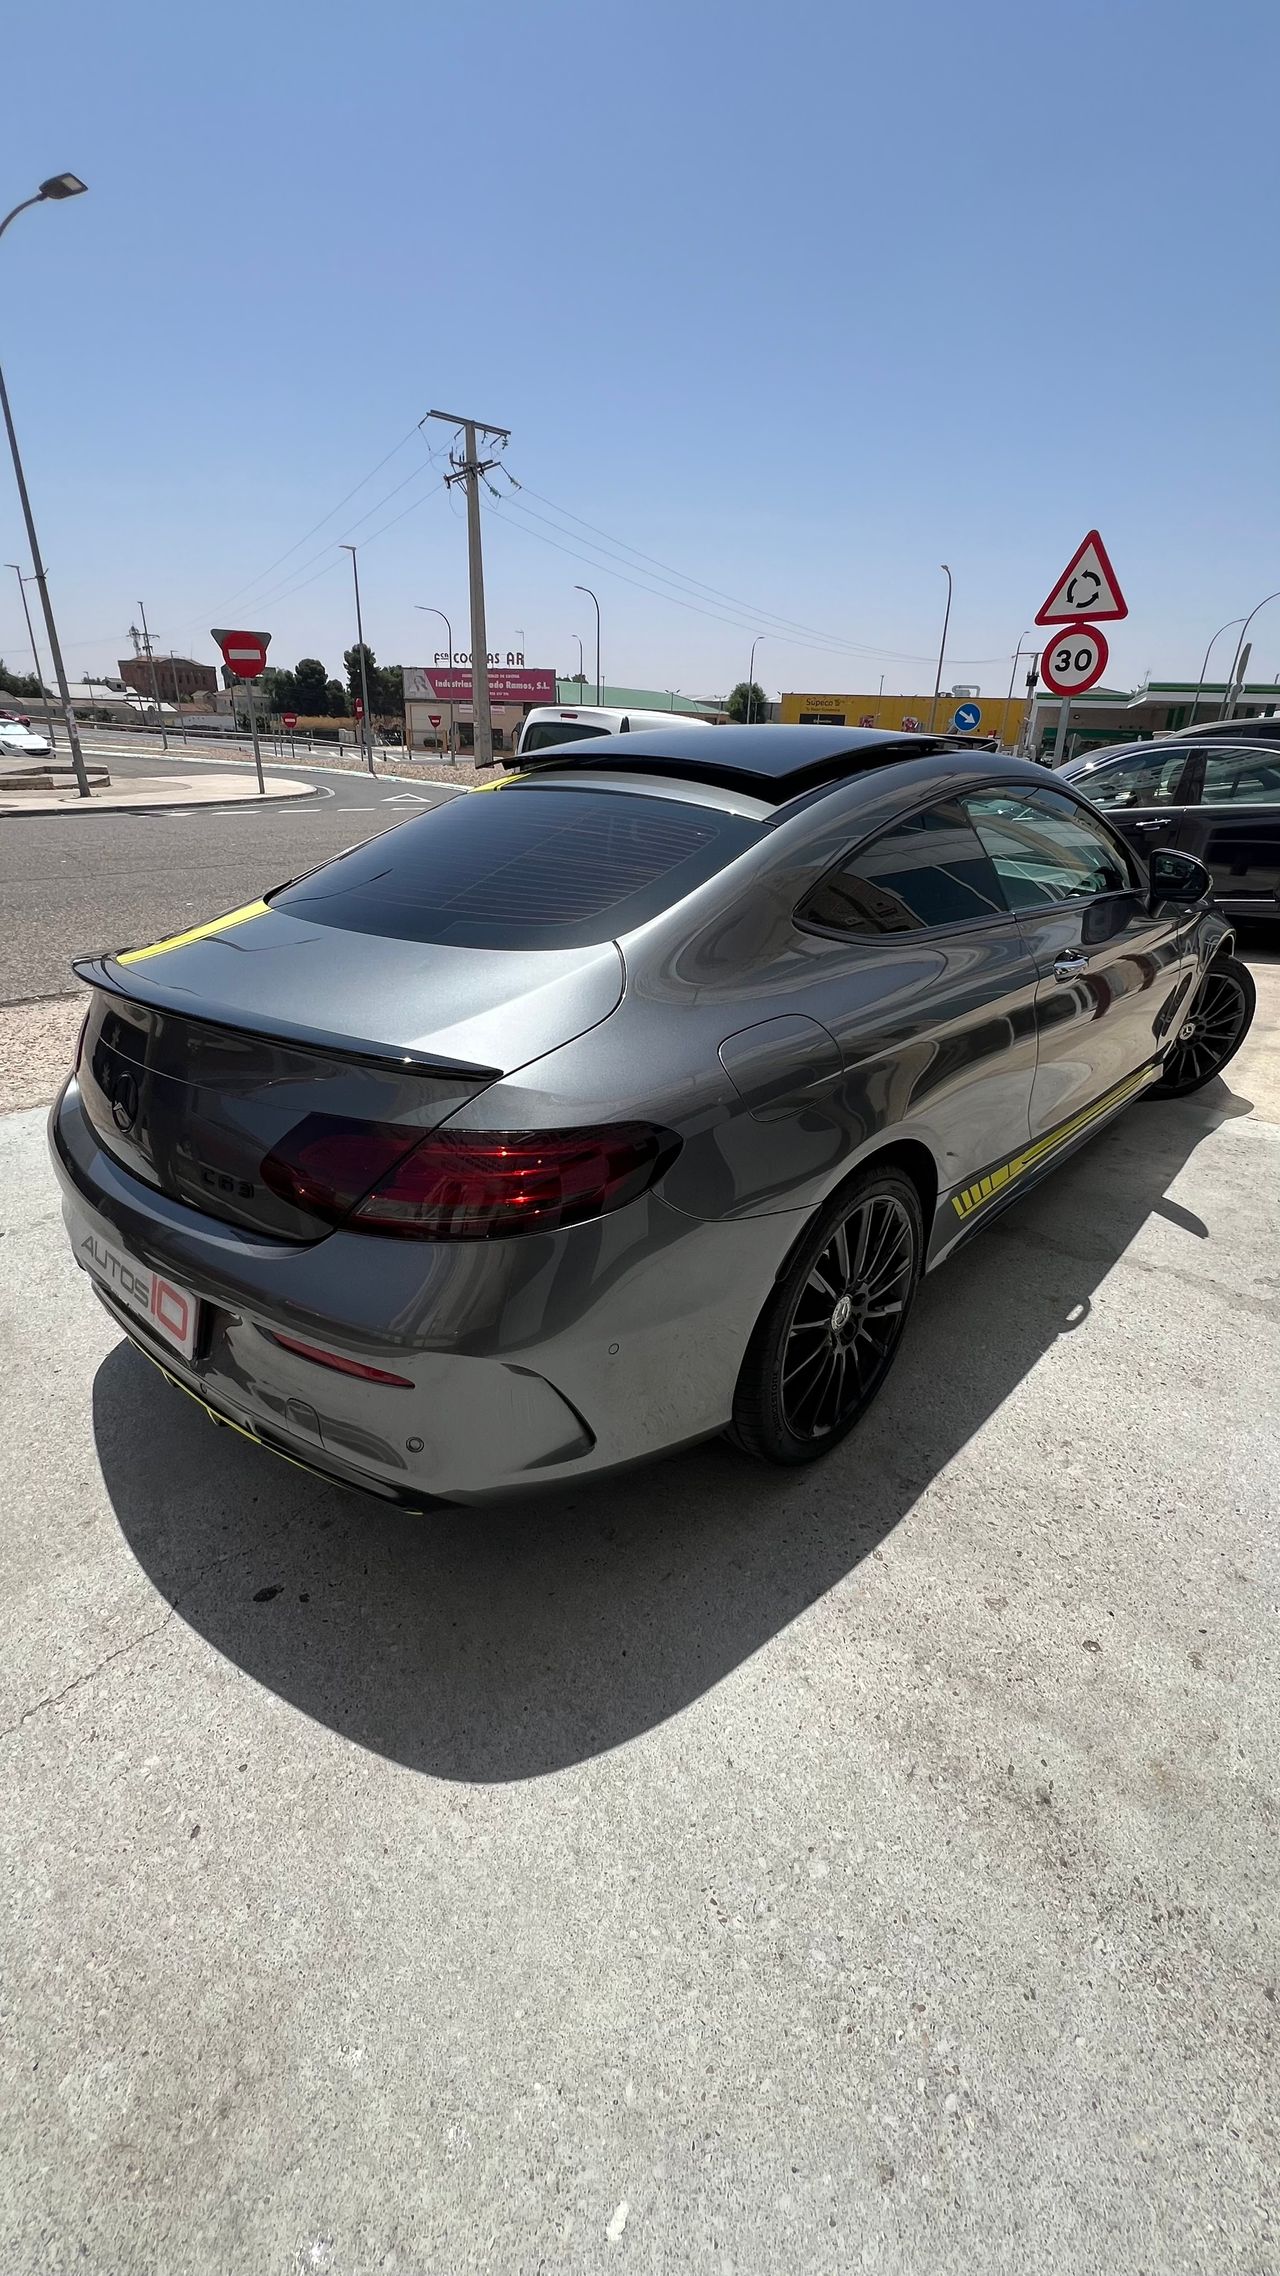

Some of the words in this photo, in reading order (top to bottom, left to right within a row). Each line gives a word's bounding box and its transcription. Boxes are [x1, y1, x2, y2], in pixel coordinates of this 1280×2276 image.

[453, 652, 500, 664] COCAS
[506, 652, 524, 666] AR
[1055, 649, 1093, 672] 30
[488, 680, 504, 688] ado
[806, 697, 834, 707] Supeco
